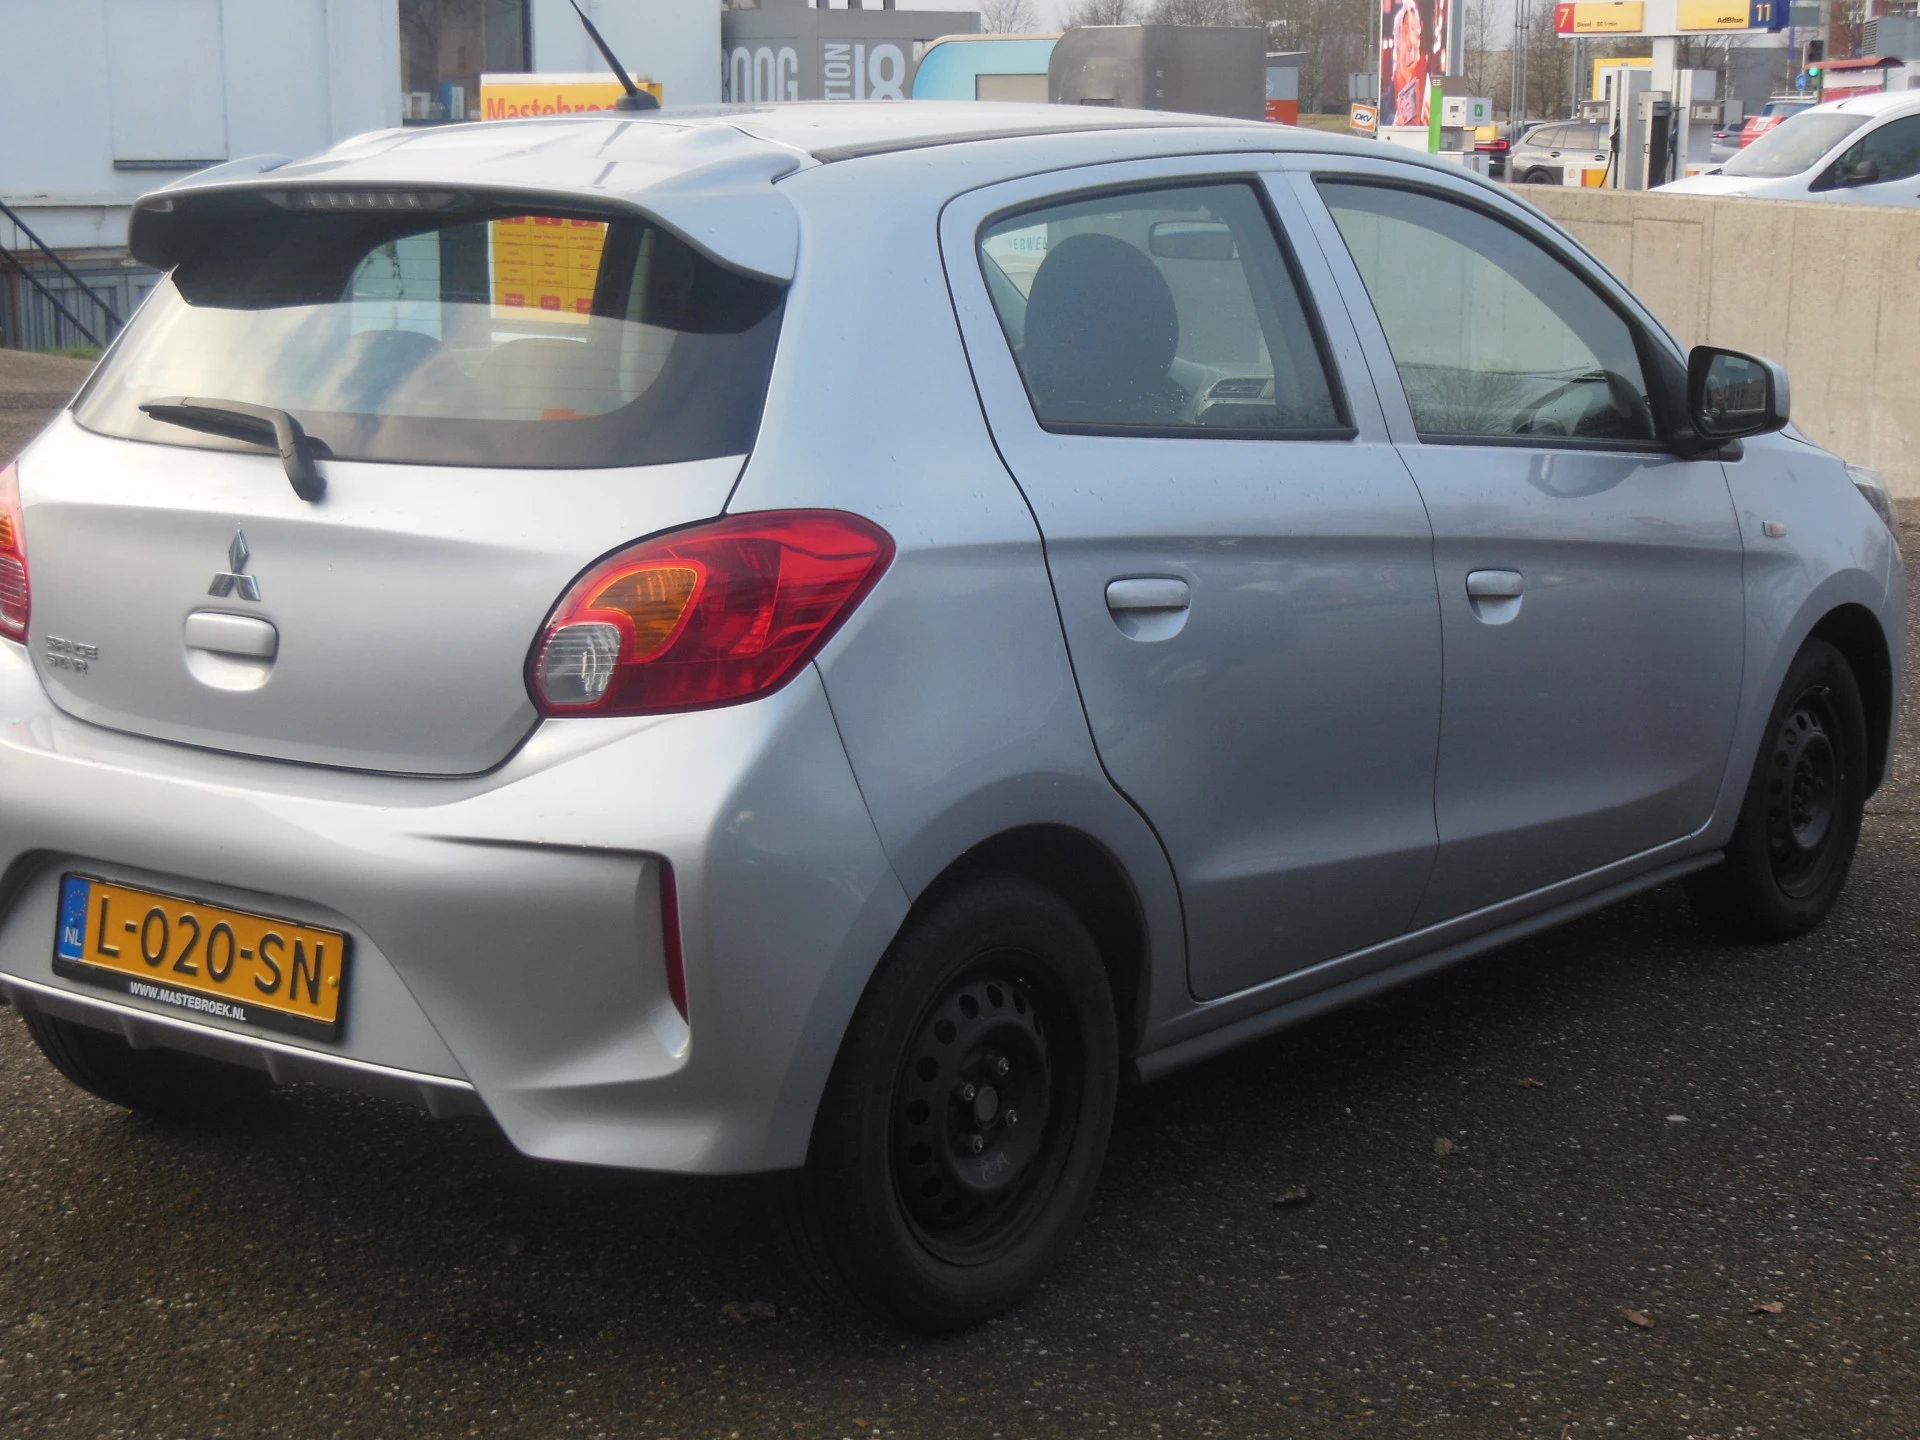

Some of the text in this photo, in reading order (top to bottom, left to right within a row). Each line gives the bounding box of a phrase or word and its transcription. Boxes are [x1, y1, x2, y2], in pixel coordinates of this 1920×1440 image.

[1560, 8, 1570, 28] 7
[1756, 4, 1772, 22] 11
[1354, 112, 1373, 123] DKV
[46, 635, 99, 661] SPACE
[46, 651, 89, 675] STAR
[64, 926, 82, 947] NL
[97, 894, 325, 1006] L-020-SN
[130, 981, 247, 1021] WWW.MASTEBROEK.NL
